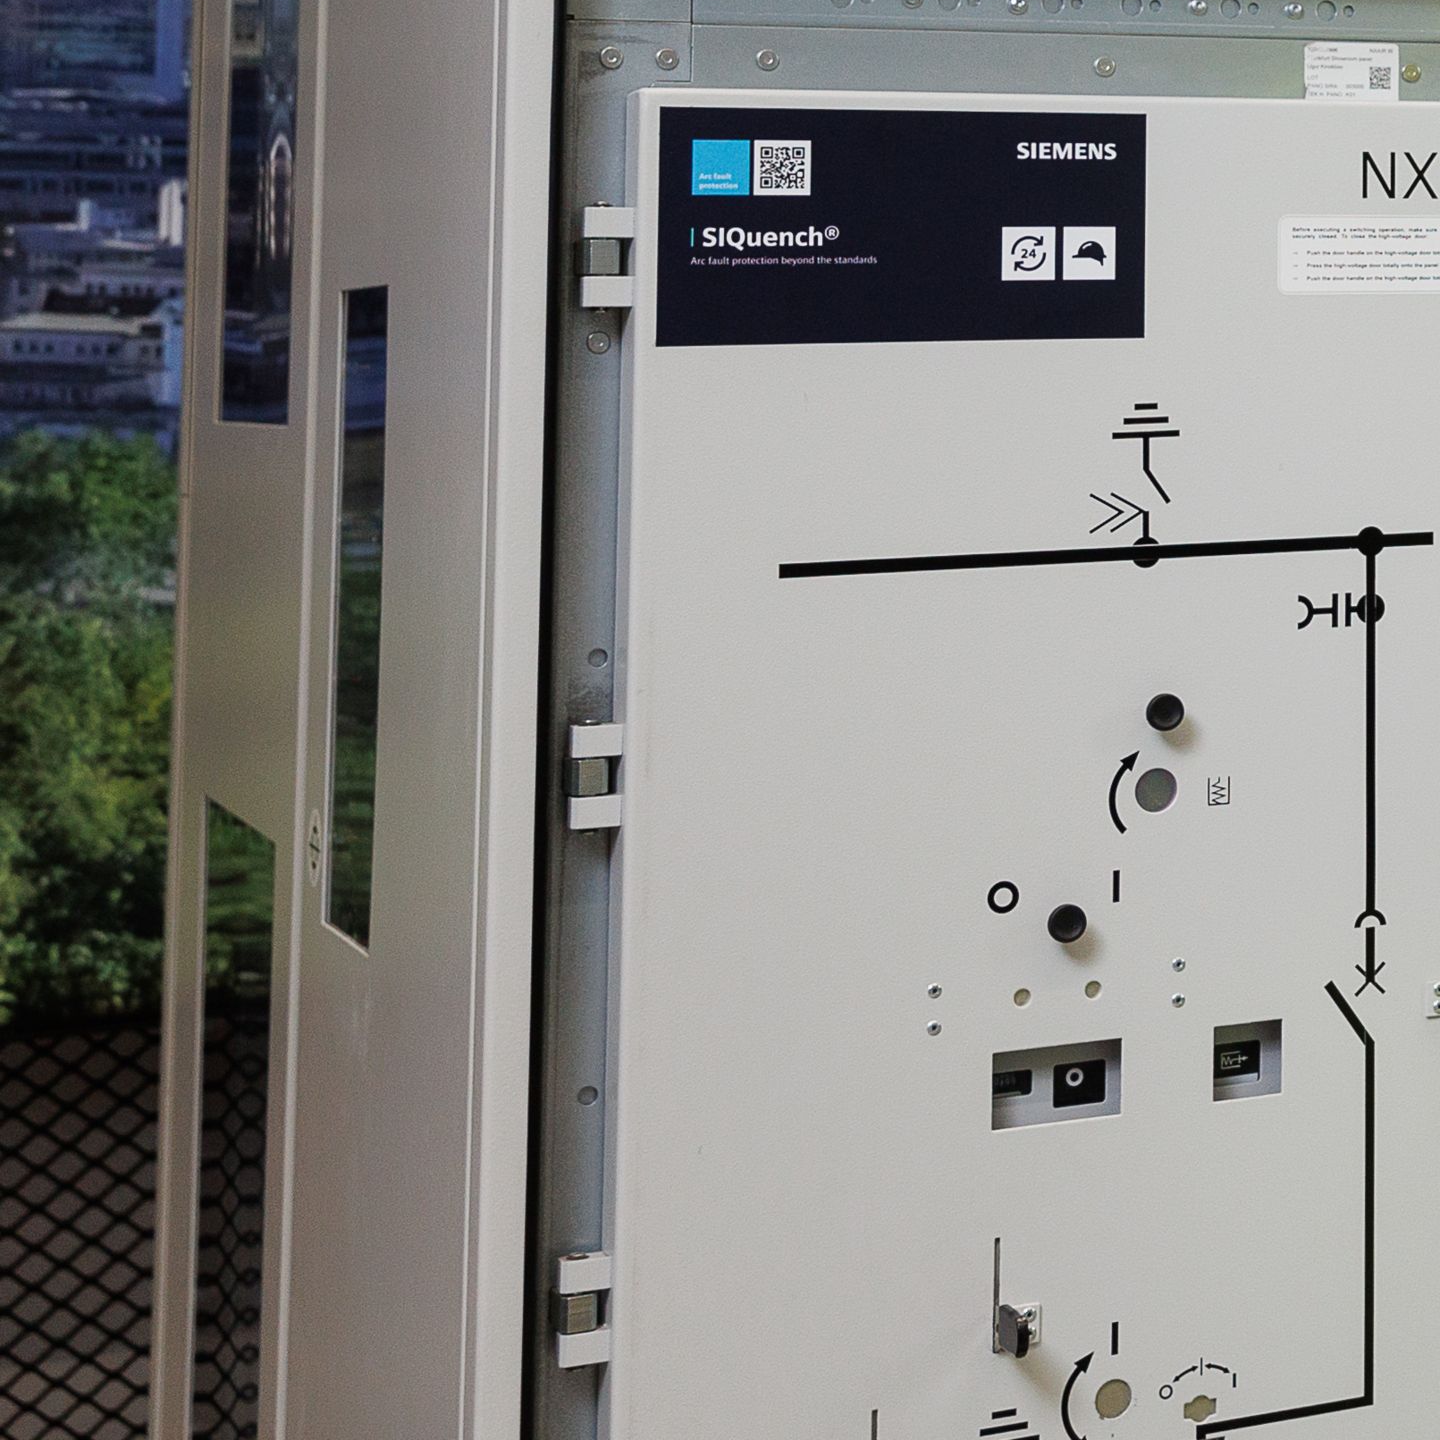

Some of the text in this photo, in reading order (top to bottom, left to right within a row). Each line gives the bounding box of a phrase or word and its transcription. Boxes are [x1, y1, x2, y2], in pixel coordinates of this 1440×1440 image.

[1016, 141, 1118, 161] SIEMENS
[699, 171, 733, 181] Arc fault
[699, 181, 739, 190] protection
[701, 225, 840, 250] SIQuench®
[1020, 248, 1037, 259] 24
[690, 255, 878, 267] Arc fault protection beyond the standards
